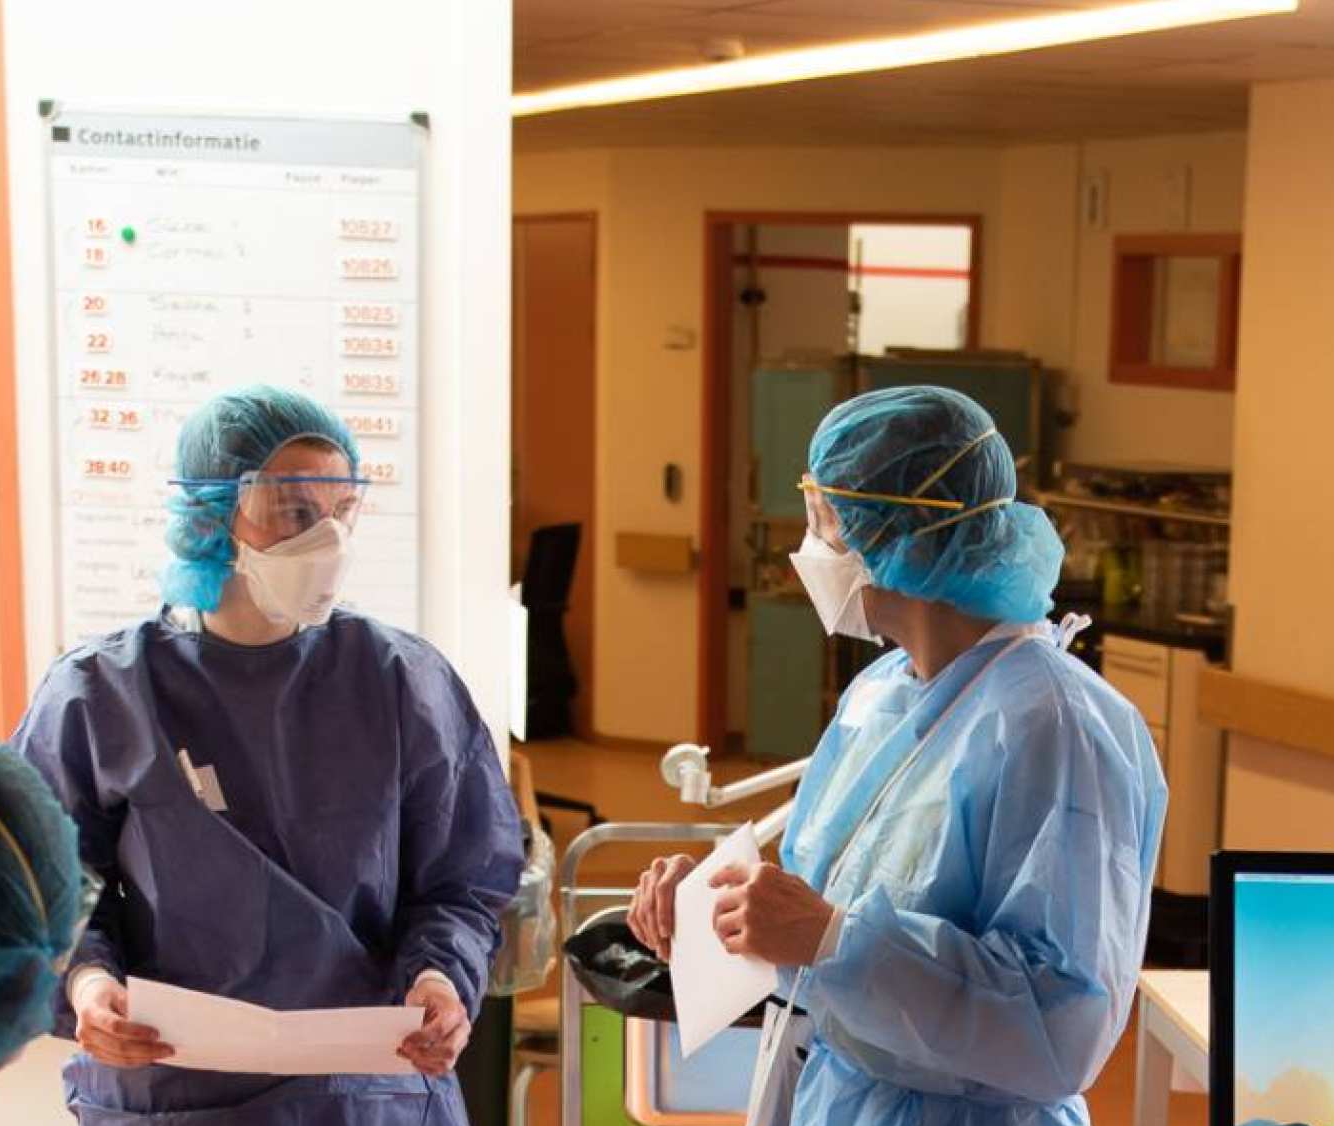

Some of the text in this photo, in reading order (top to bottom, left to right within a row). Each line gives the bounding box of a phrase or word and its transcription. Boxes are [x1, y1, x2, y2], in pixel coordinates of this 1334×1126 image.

[77, 128, 261, 151] Contactinformatie
[83, 295, 105, 310] 20
[87, 333, 108, 347] 22
